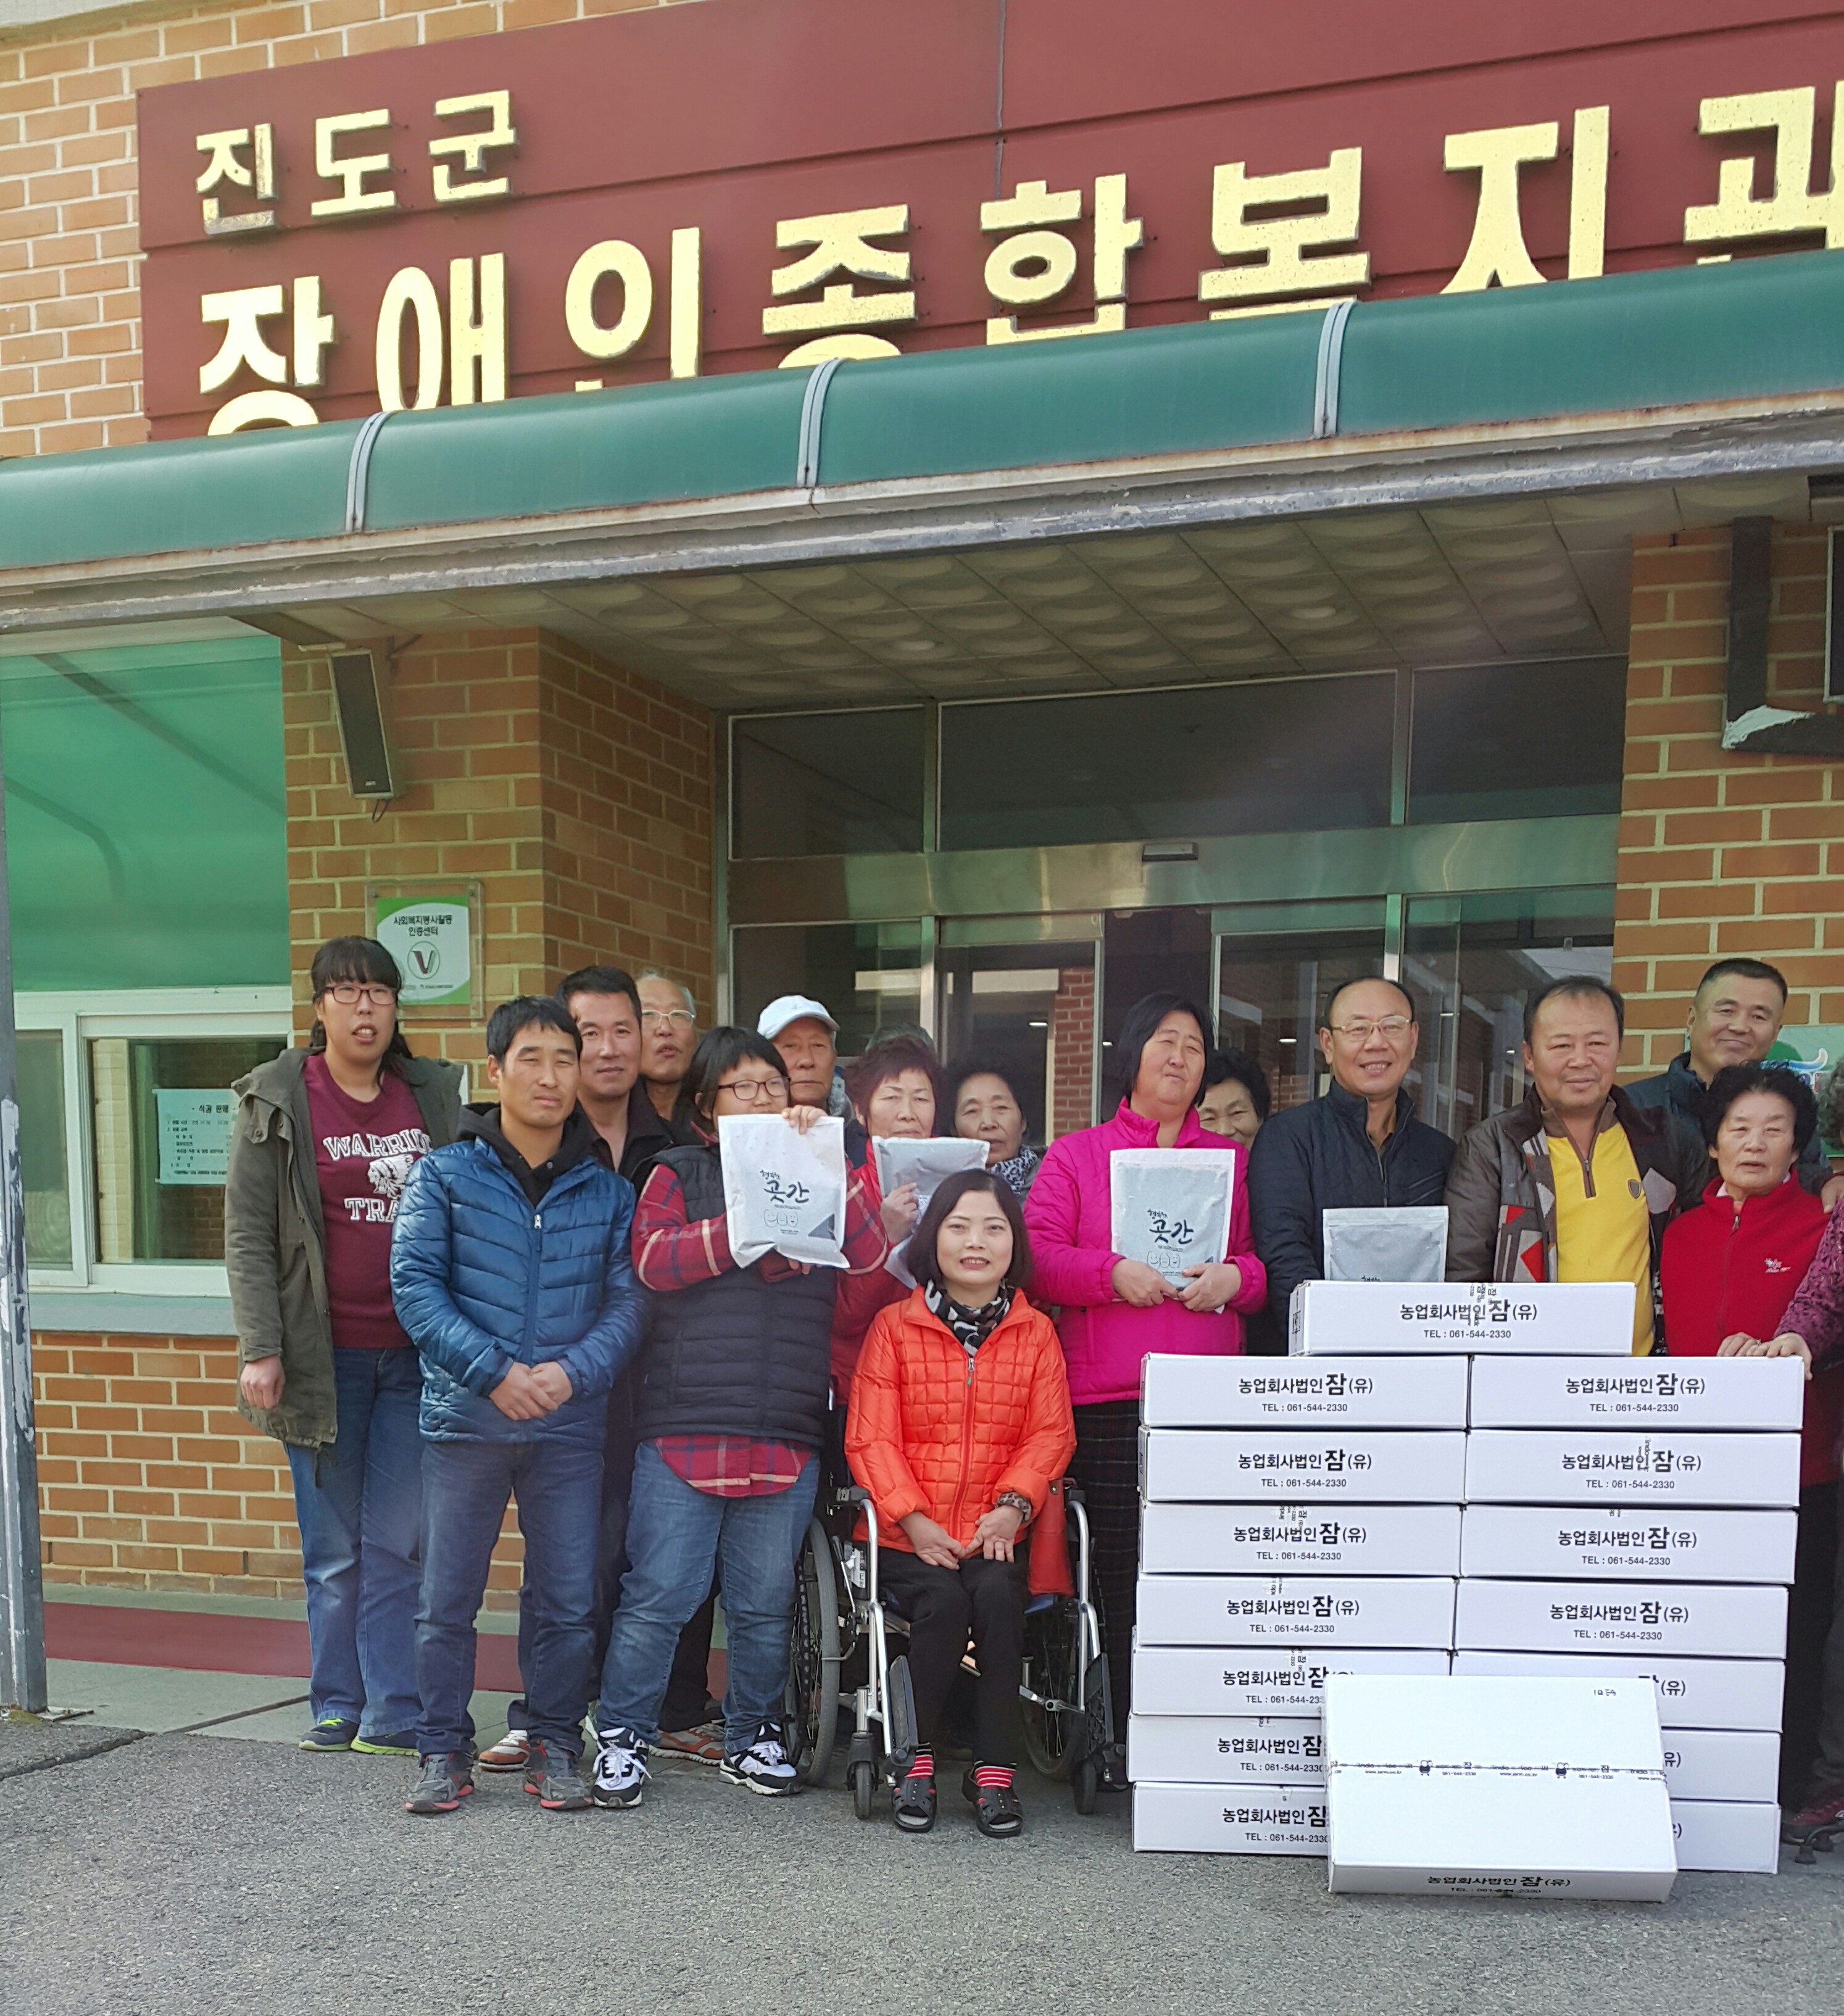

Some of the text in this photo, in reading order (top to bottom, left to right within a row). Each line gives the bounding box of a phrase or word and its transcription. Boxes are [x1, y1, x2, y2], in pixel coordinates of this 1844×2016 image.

[195, 88, 519, 235] 진도군
[763, 1180, 810, 1203] 곳간
[1148, 1219, 1194, 1245] 곳간
[1449, 1329, 1511, 1338] 061-544-2330
[1287, 1403, 1348, 1412] 061-544-2330
[1616, 1403, 1679, 1412] 061-544-2330
[1285, 1479, 1347, 1487] 061-544-2330
[1611, 1480, 1675, 1489] 061-544-2330
[1281, 1551, 1342, 1561] 061-544-2330
[1607, 1556, 1671, 1566] 061-544-2330
[1274, 1624, 1335, 1633] 061-544-2330
[1599, 1630, 1663, 1640] 061-544-2330
